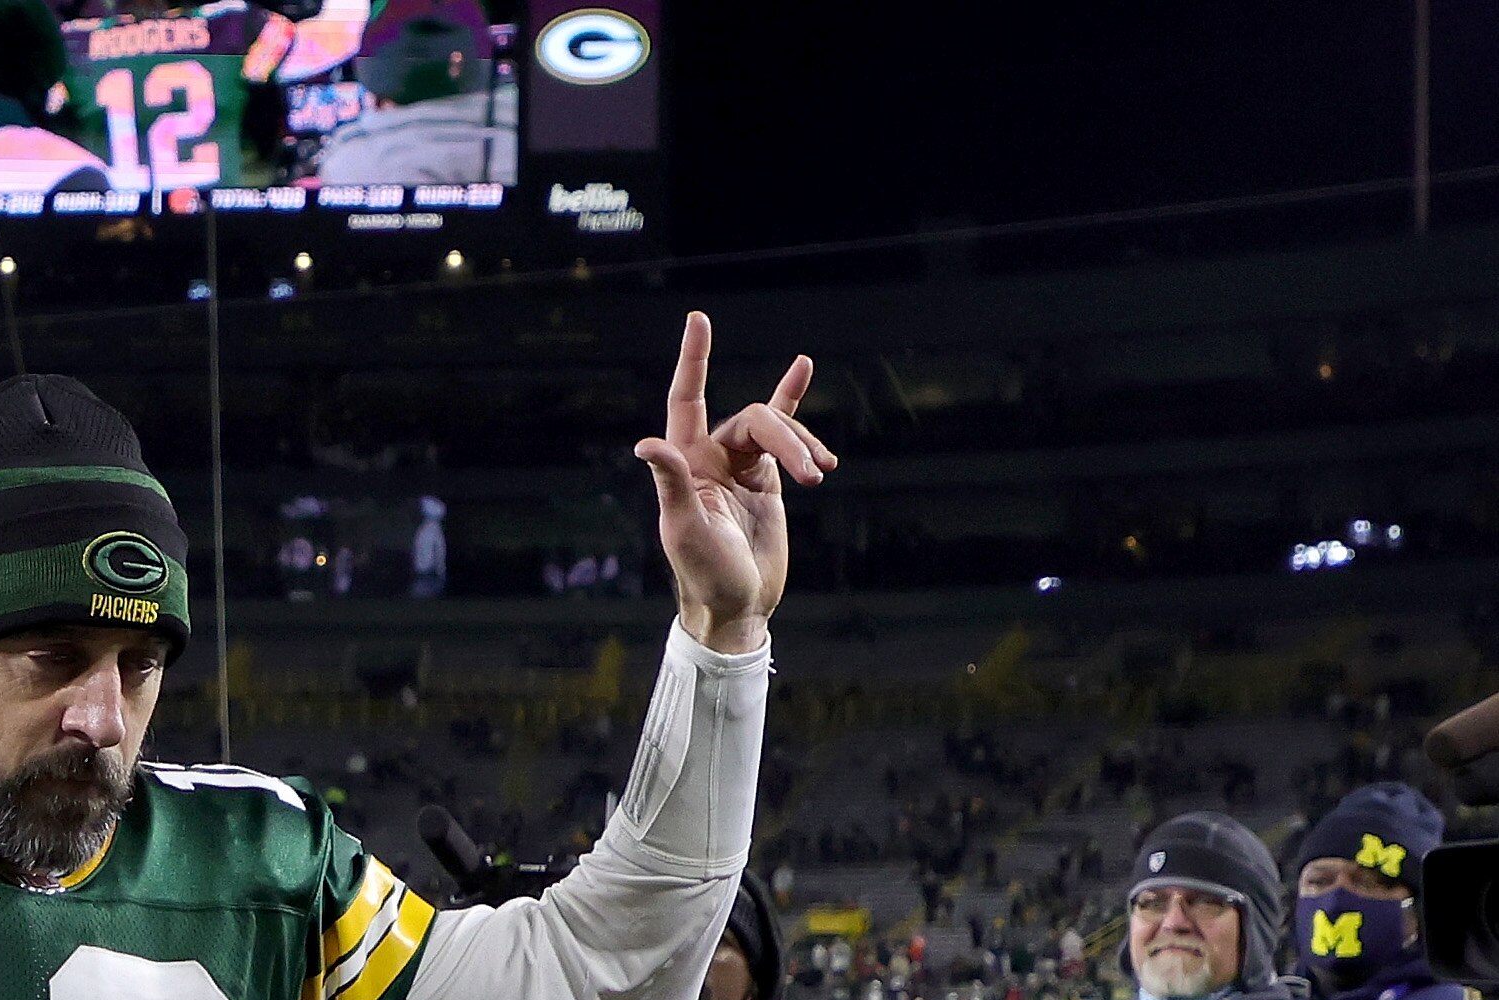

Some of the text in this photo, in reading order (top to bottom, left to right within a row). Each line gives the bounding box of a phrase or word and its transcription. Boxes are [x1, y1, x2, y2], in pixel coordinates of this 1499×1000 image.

[96, 60, 221, 190] 12
[90, 593, 160, 624] PACKERS
[1355, 833, 1406, 877] M
[1311, 909, 1362, 958] M
